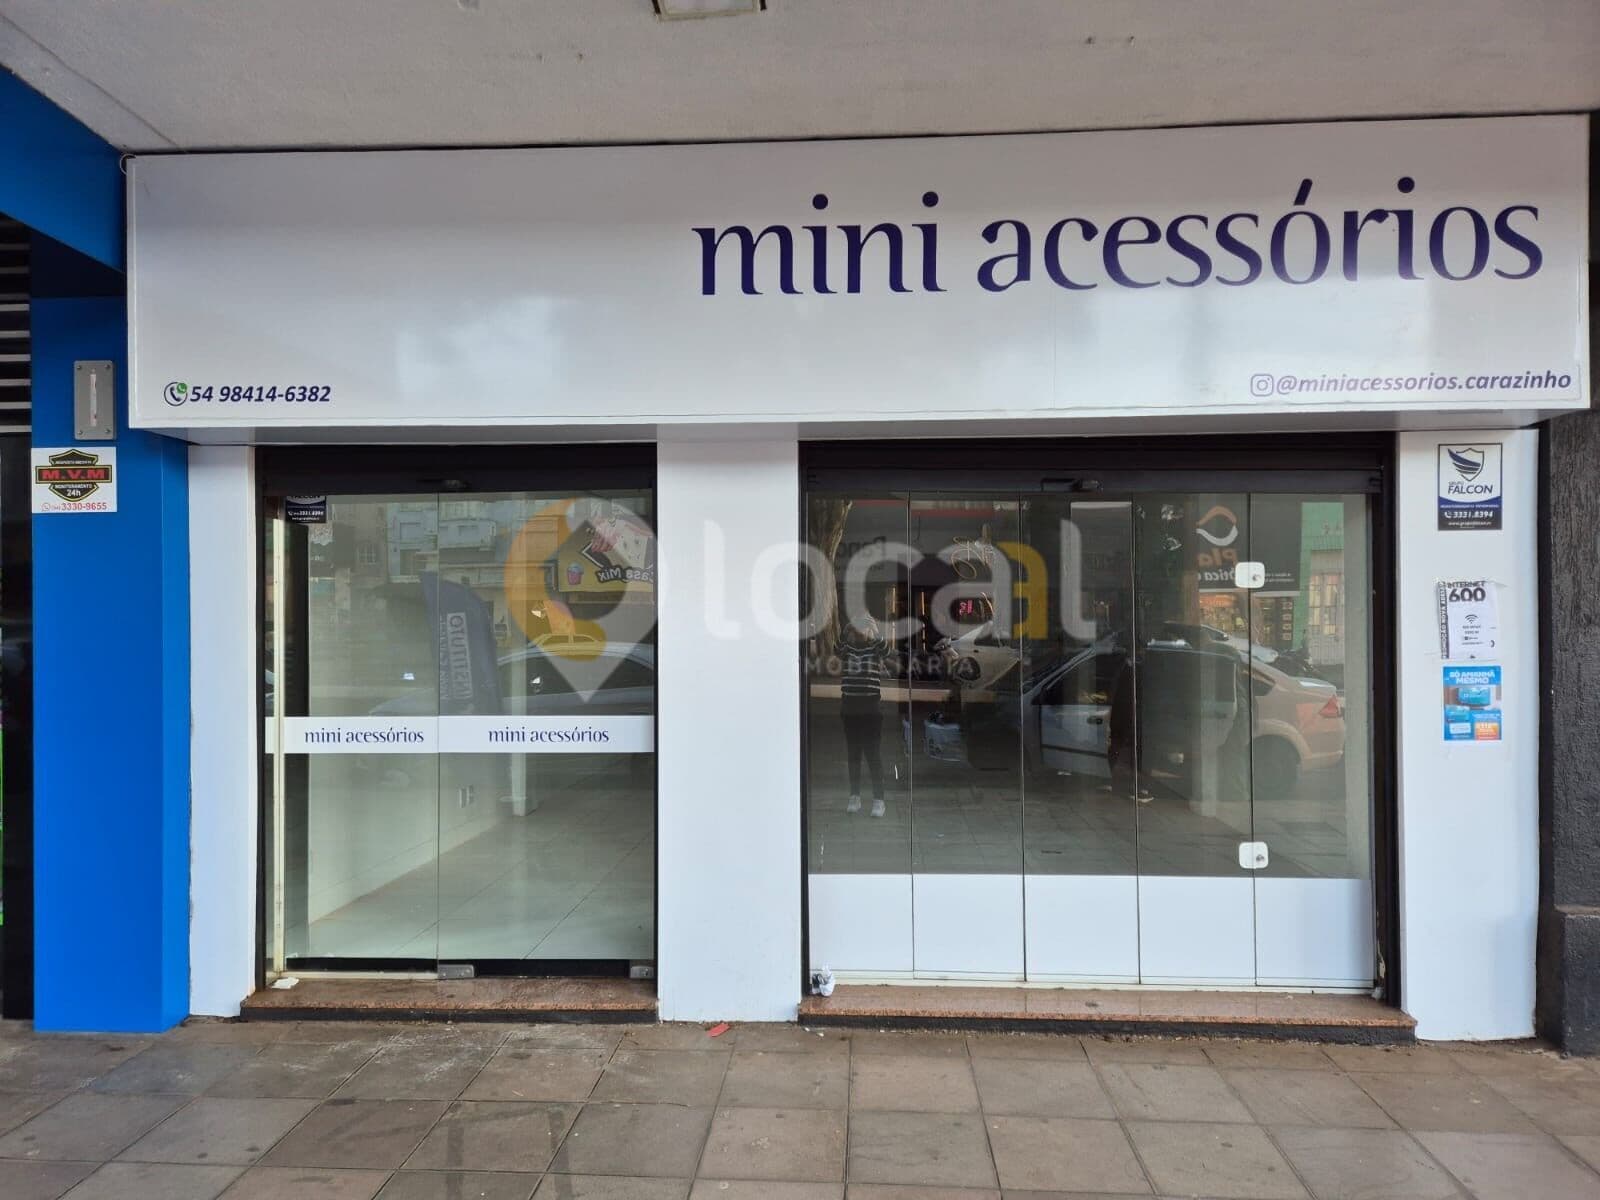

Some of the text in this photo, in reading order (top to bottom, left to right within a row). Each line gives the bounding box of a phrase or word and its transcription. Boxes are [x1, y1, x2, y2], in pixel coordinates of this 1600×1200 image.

[692, 177, 1542, 295] mini acessórios
[1276, 370, 1572, 396] @miniacessorios.carazinho
[190, 385, 331, 402] 54 98414-6382
[41, 469, 105, 480] M.V.M
[66, 489, 81, 497] 24h
[1448, 485, 1494, 495] FALCON
[61, 502, 107, 511] 3330-9655
[1448, 587, 1487, 602] 600
[305, 726, 425, 744] mini acessórios
[488, 726, 610, 743] mini acessórios
